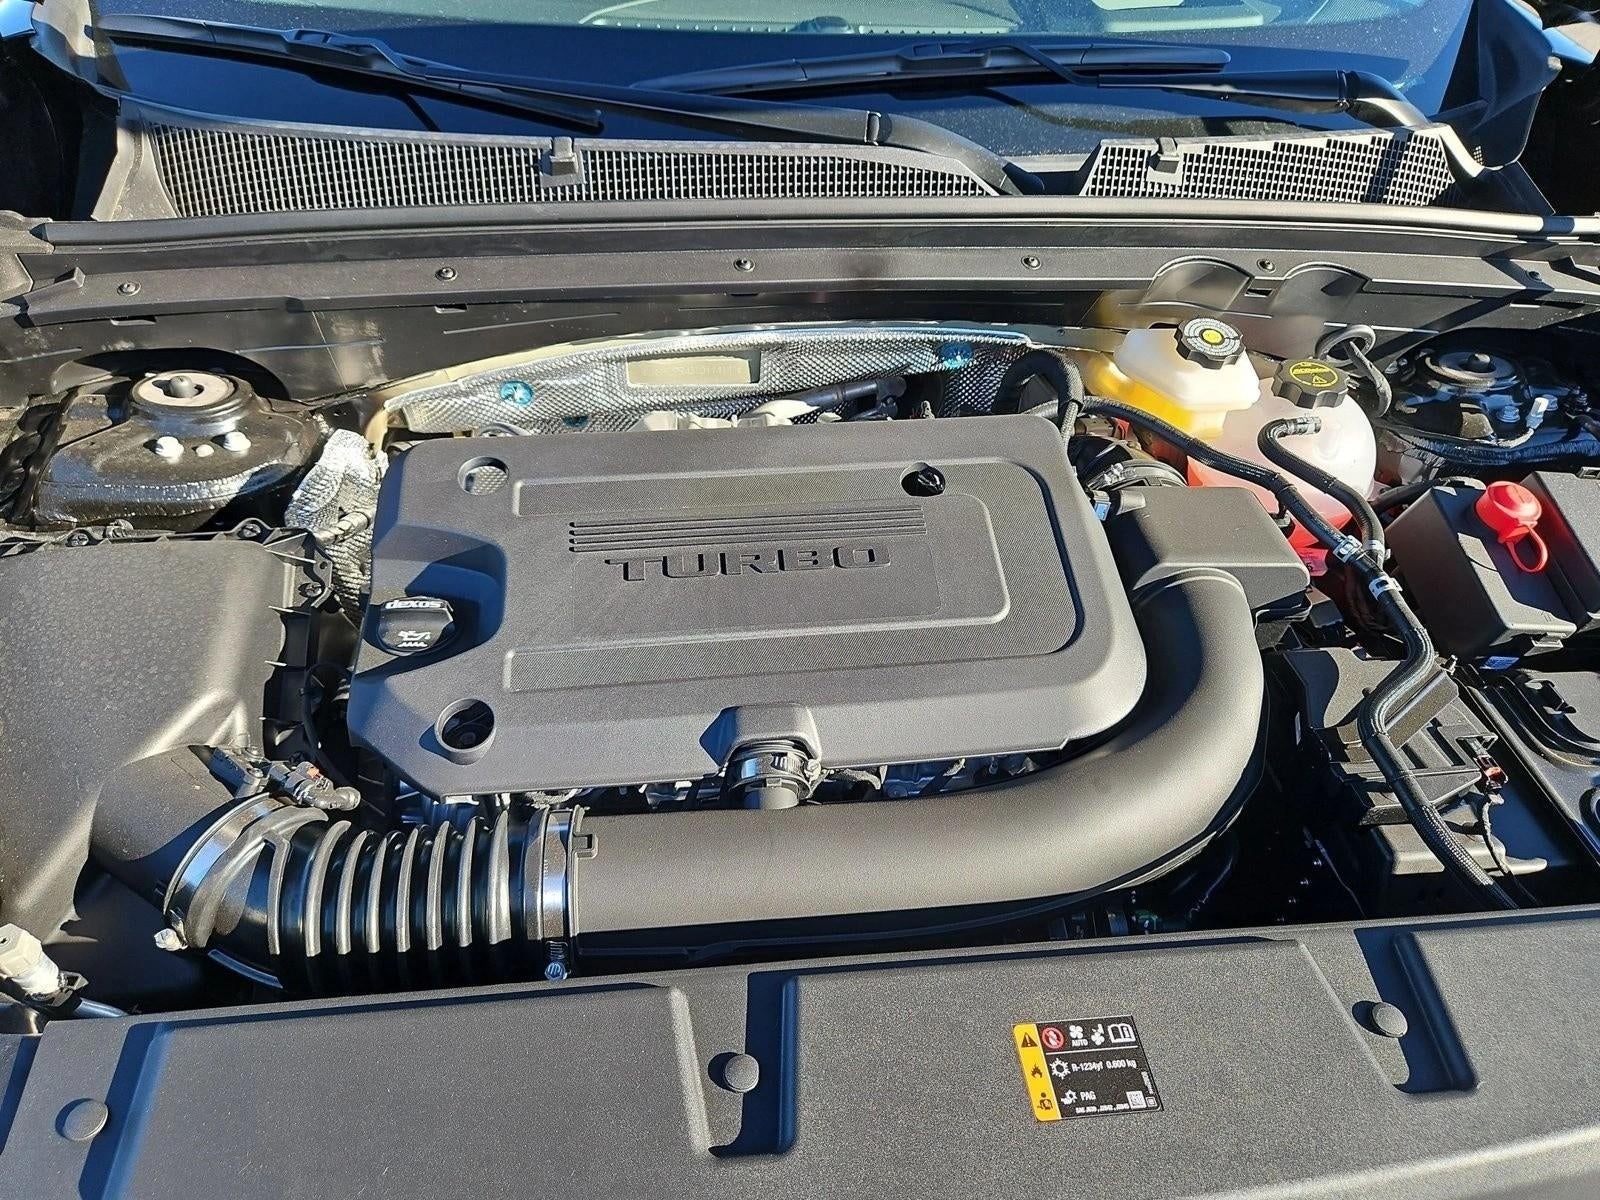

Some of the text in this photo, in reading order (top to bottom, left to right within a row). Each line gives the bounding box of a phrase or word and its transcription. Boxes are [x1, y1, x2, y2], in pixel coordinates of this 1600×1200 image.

[604, 545, 891, 582] TURBO
[385, 600, 441, 609] dexos
[1072, 1039, 1089, 1047] AUTO
[1071, 1059, 1137, 1072] R-1234yf 0.600 kg
[1080, 1091, 1096, 1101] PAG
